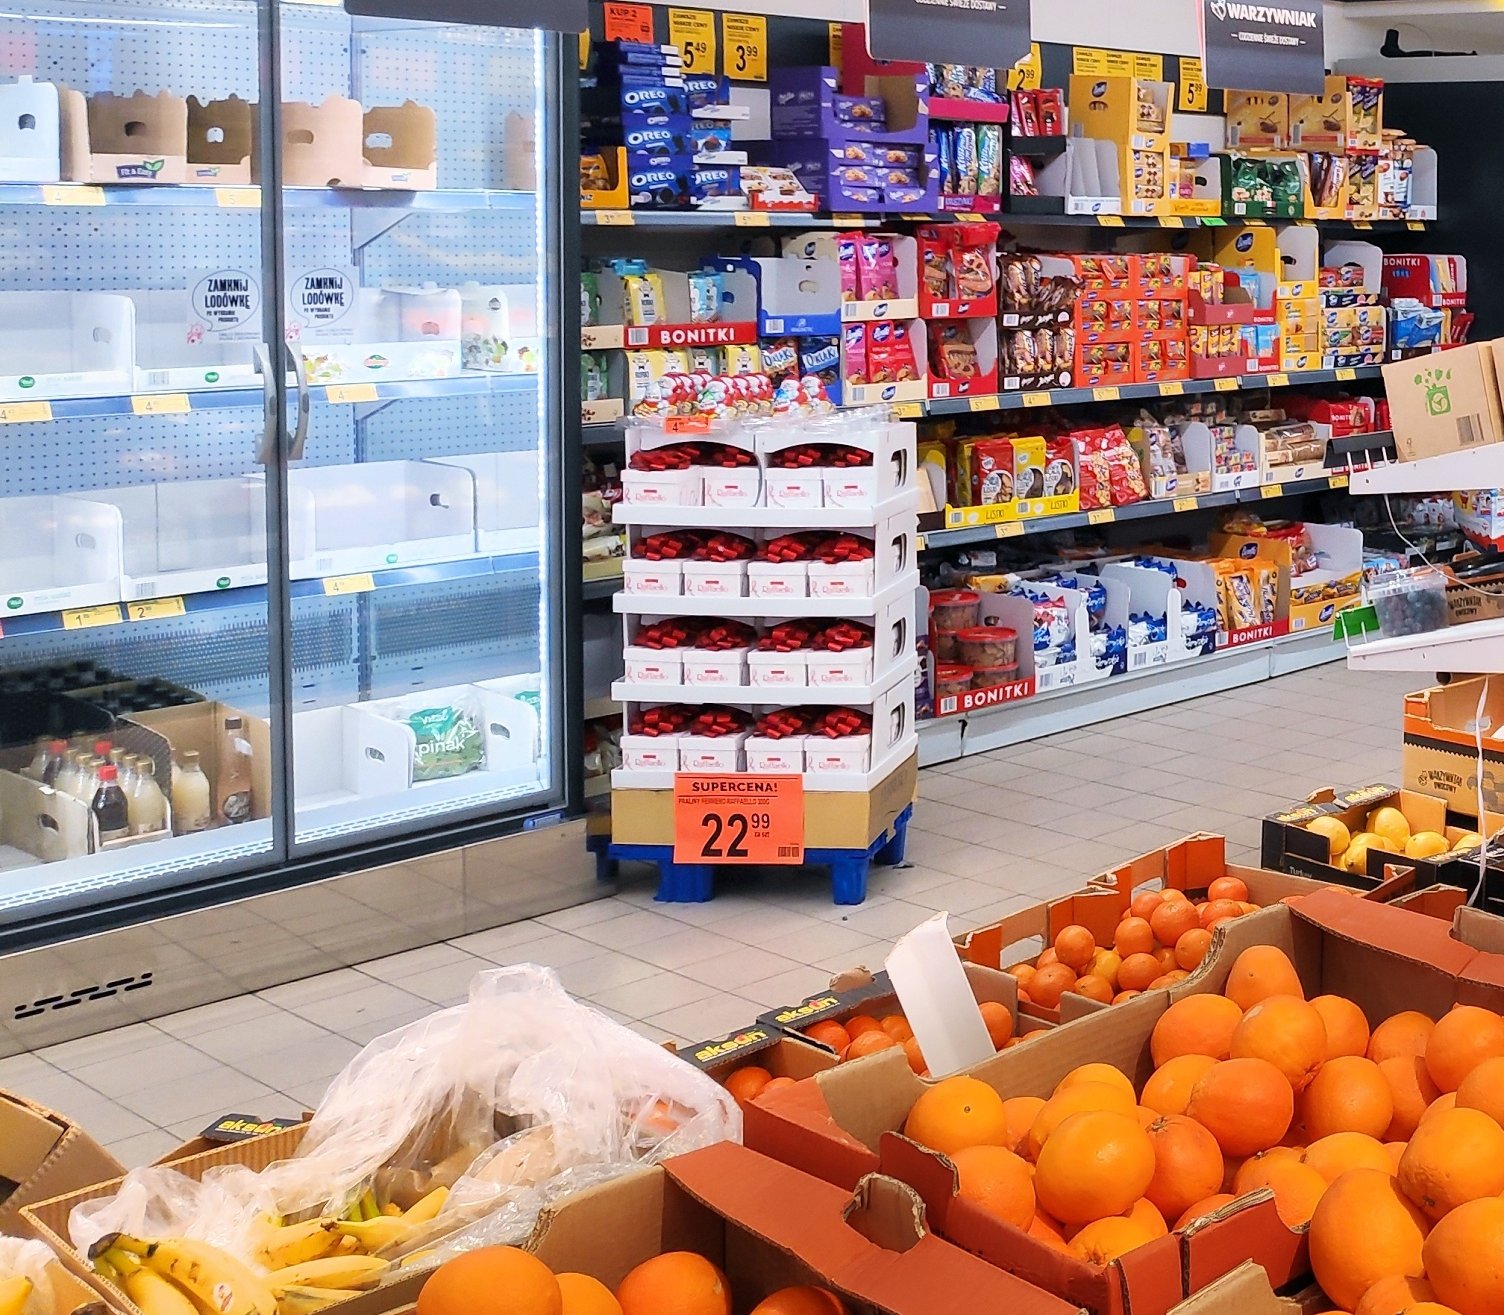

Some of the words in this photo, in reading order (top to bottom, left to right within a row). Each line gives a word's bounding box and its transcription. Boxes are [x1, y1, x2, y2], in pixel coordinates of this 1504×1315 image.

[1226, 2, 1317, 28] WARZYWNIAK
[683, 41, 694, 68] 5
[736, 44, 746, 71] 3
[746, 46, 758, 57] 99
[1017, 69, 1027, 90] 2
[625, 90, 665, 104] OREO
[1187, 83, 1194, 104] 5
[628, 131, 670, 145] OREO
[632, 171, 675, 186] OREO
[1383, 257, 1421, 267] BONITKI
[205, 292, 251, 309] LODÓWKĘ
[302, 290, 345, 307] LODÓWKĘ
[660, 328, 735, 344] BONITKI
[1232, 625, 1273, 643] BONITKI
[963, 681, 1029, 708] BONITKI
[418, 736, 465, 755] pinak
[692, 782, 778, 792] SUPERCENA!
[701, 813, 748, 857] 22
[751, 812, 770, 829] 99
